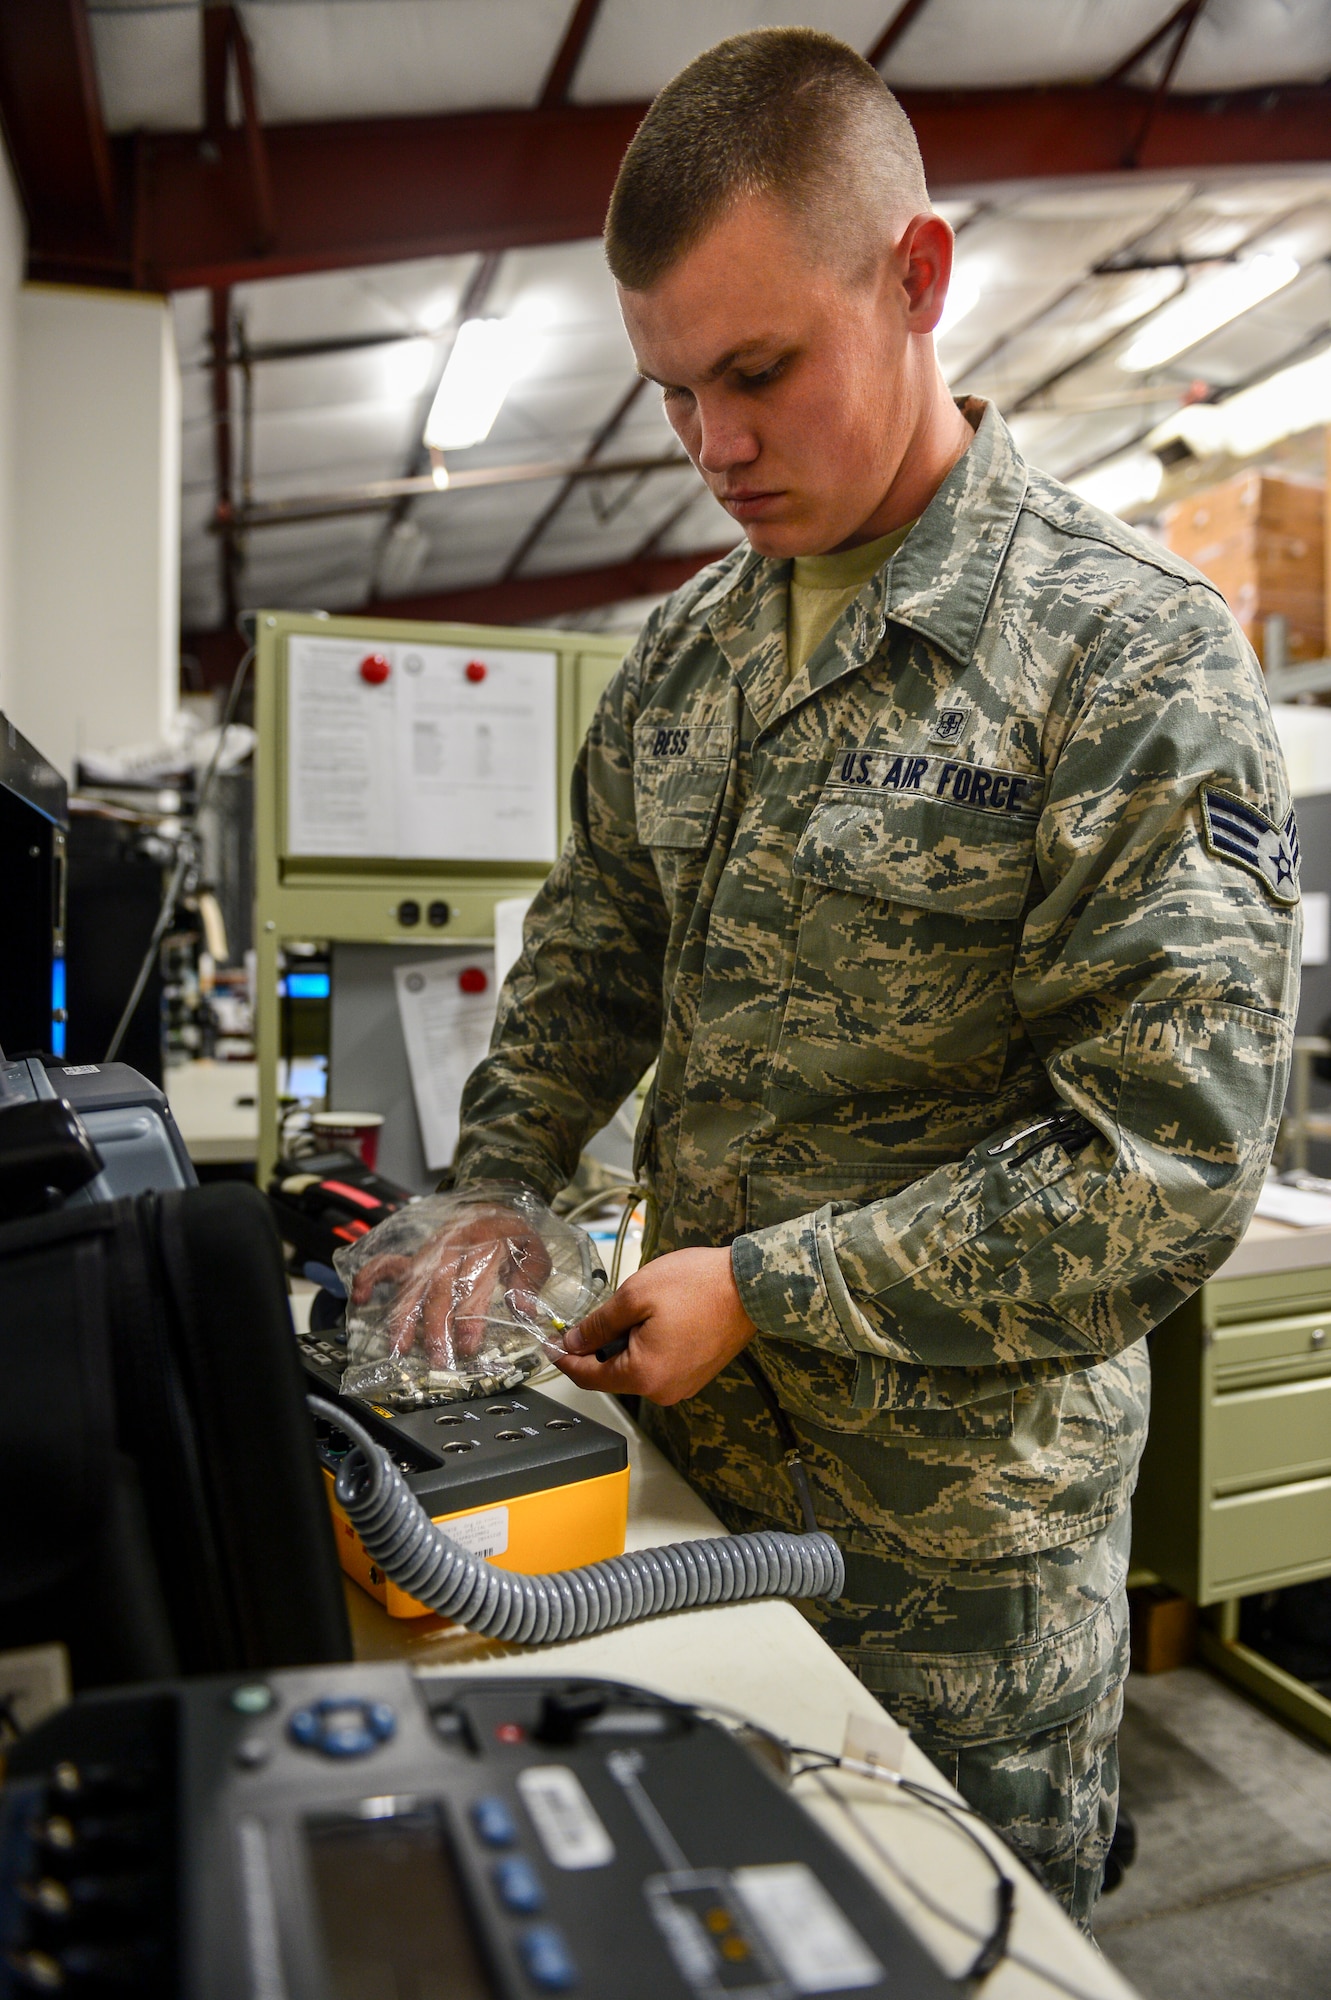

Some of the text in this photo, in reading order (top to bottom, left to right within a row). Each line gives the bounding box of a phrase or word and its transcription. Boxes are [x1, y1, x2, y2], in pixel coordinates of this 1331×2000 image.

[653, 730, 690, 756] BESS
[841, 753, 1027, 811] U.S. AIR FORCE
